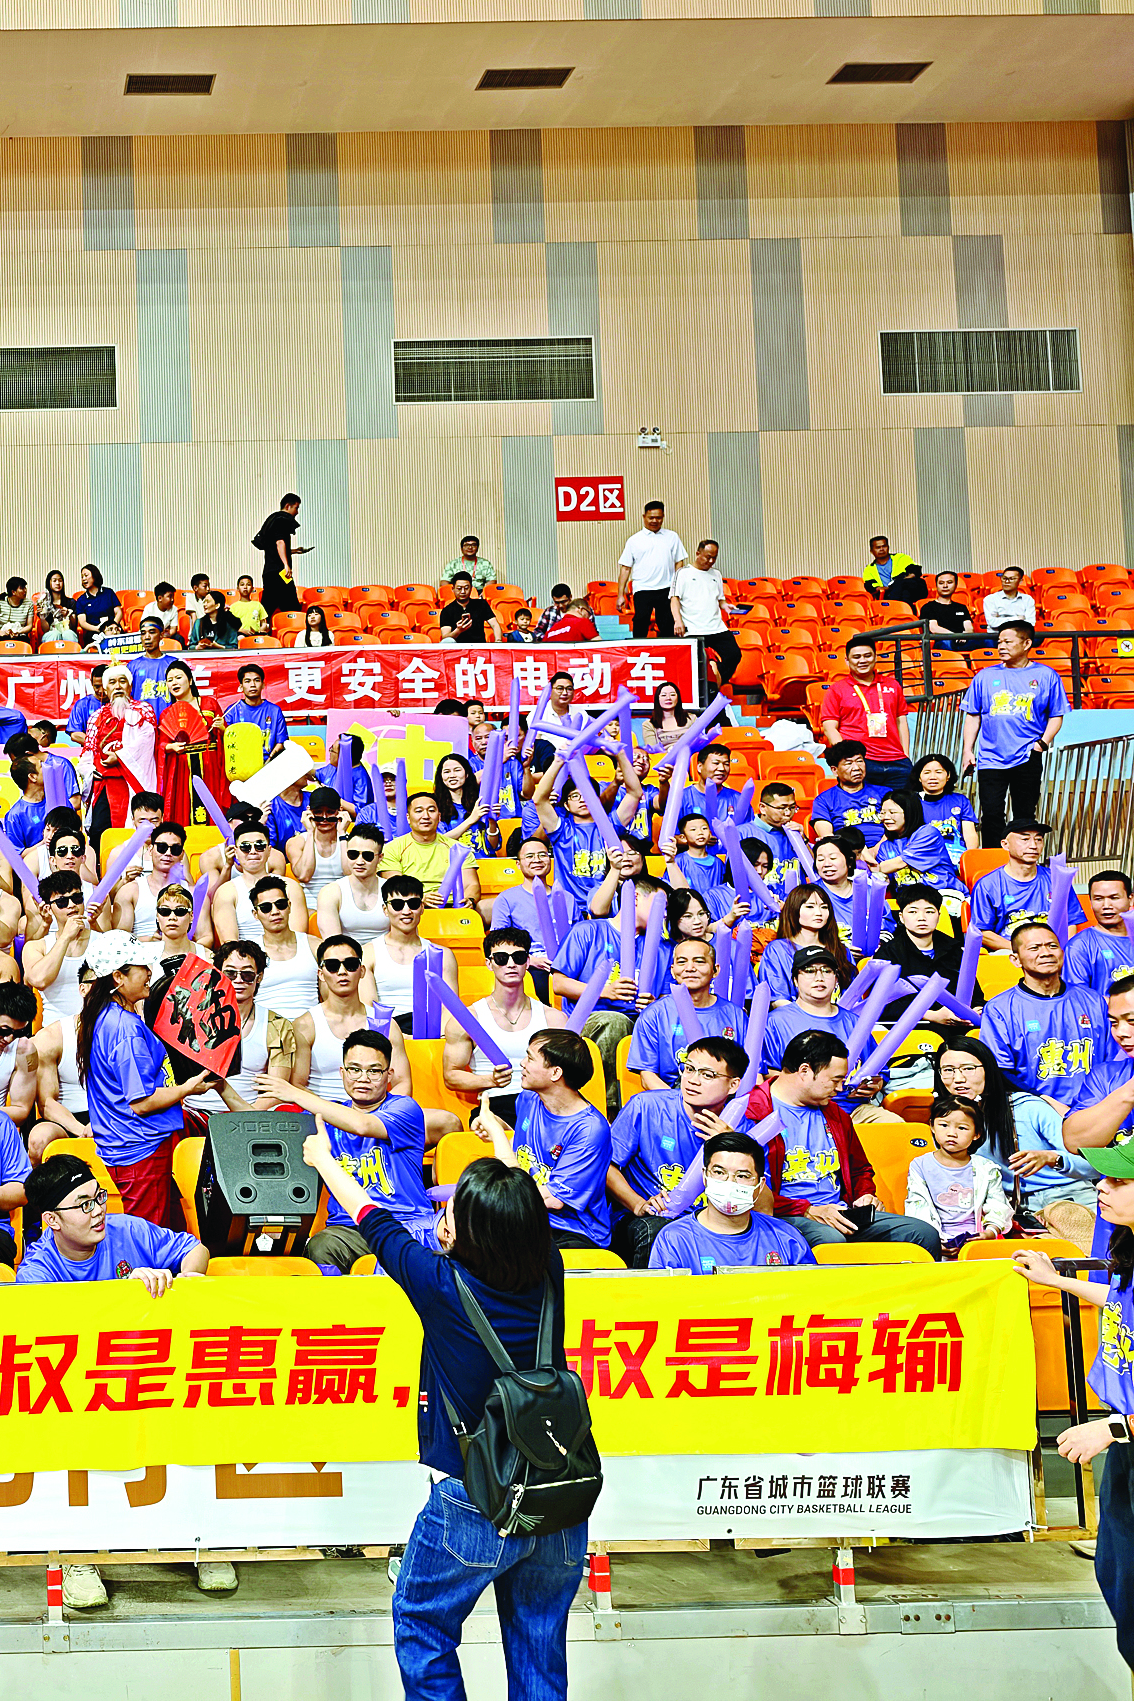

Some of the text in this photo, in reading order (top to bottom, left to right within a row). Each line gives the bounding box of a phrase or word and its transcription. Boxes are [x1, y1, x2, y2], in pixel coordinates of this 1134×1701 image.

[557, 484, 624, 512] D2区
[284, 652, 668, 703] 更安全的电动车
[989, 690, 1035, 722] 惠州
[1037, 1038, 1094, 1081] 惠州
[565, 1311, 964, 1401] 叔是梅输
[697, 1474, 911, 1500] 广东省城市篮球联赛
[697, 1503, 912, 1516] GUANGDONG CITY BASKETBALL LEAGUE
